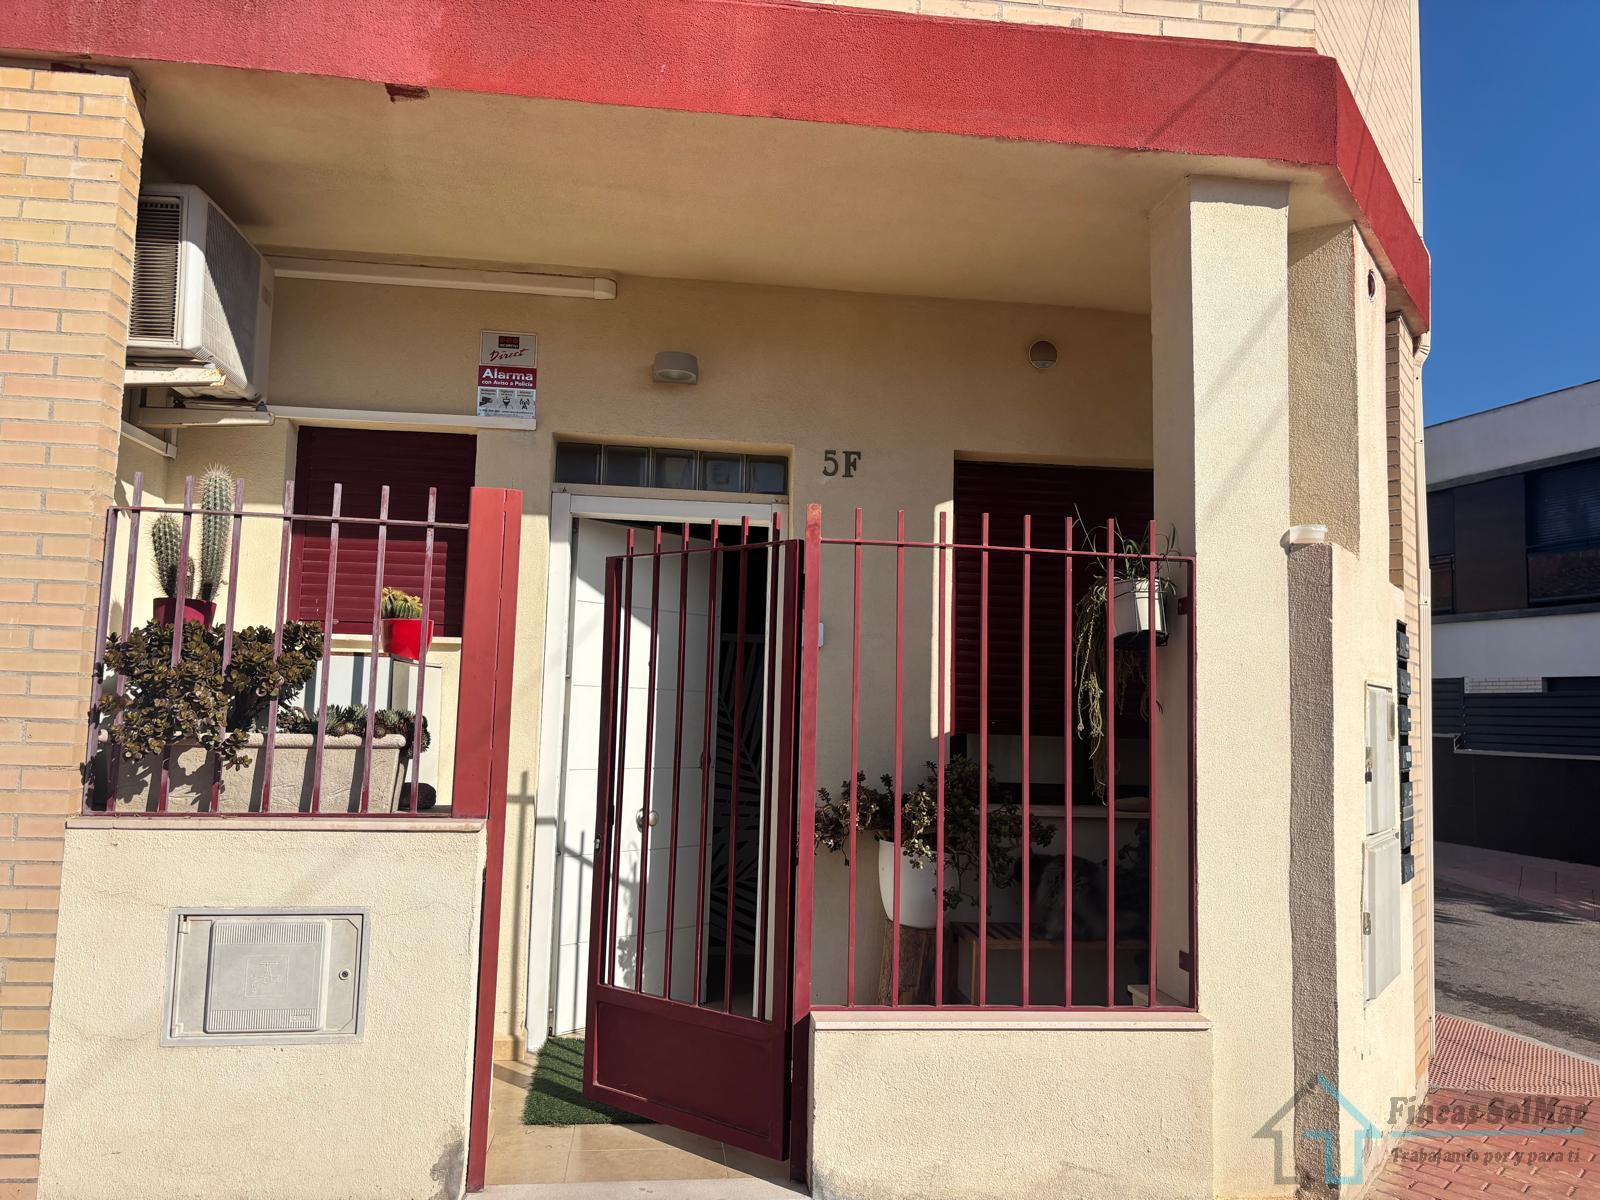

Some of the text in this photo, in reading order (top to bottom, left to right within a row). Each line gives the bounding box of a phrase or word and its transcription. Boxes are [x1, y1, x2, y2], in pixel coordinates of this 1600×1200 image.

[489, 348, 529, 362] Direct
[481, 368, 533, 381] Alarma
[822, 449, 862, 478] 5F
